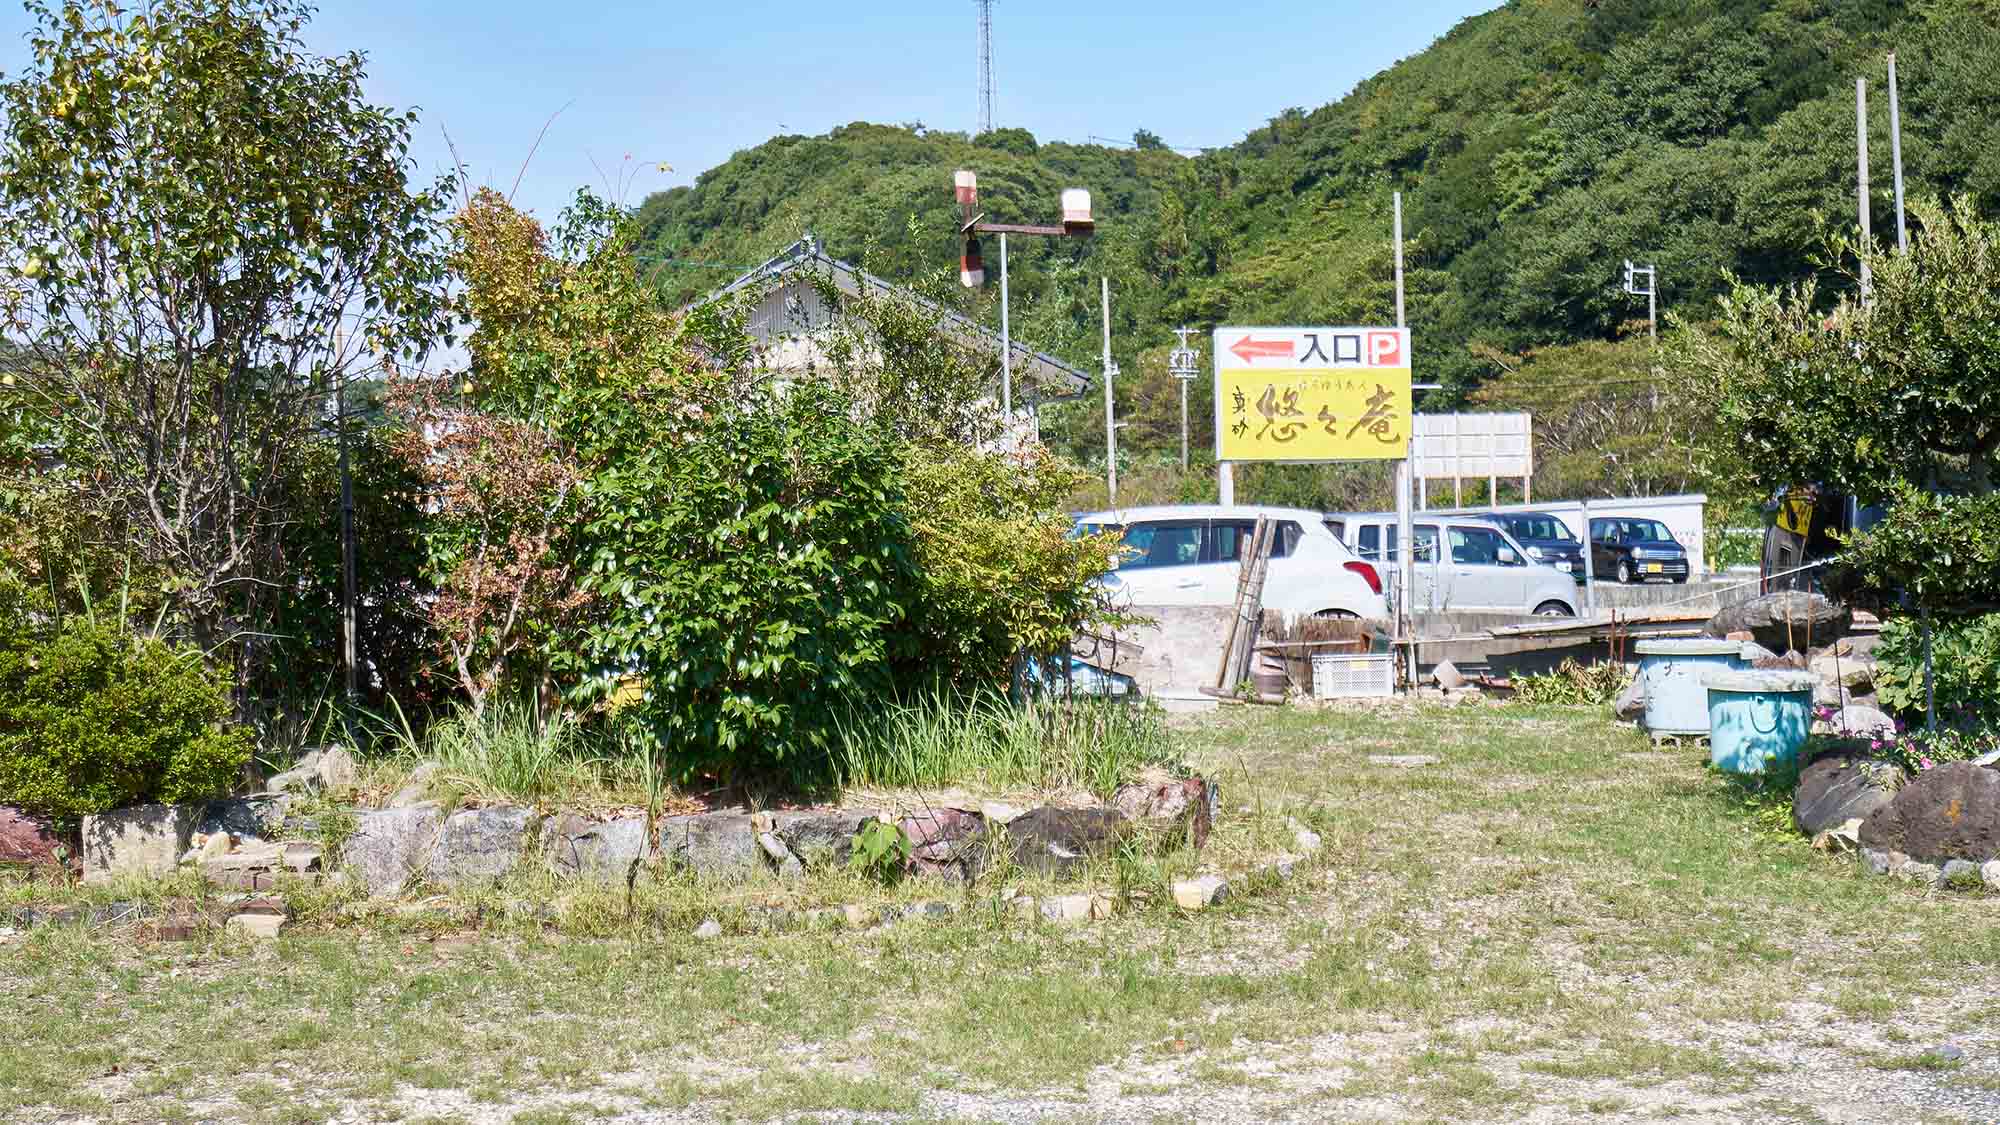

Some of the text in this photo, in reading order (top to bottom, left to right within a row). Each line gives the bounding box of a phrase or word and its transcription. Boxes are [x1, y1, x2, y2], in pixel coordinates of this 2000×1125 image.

[1299, 333, 1398, 365] 入口 P
[1255, 383, 1401, 444] 悠々庵
